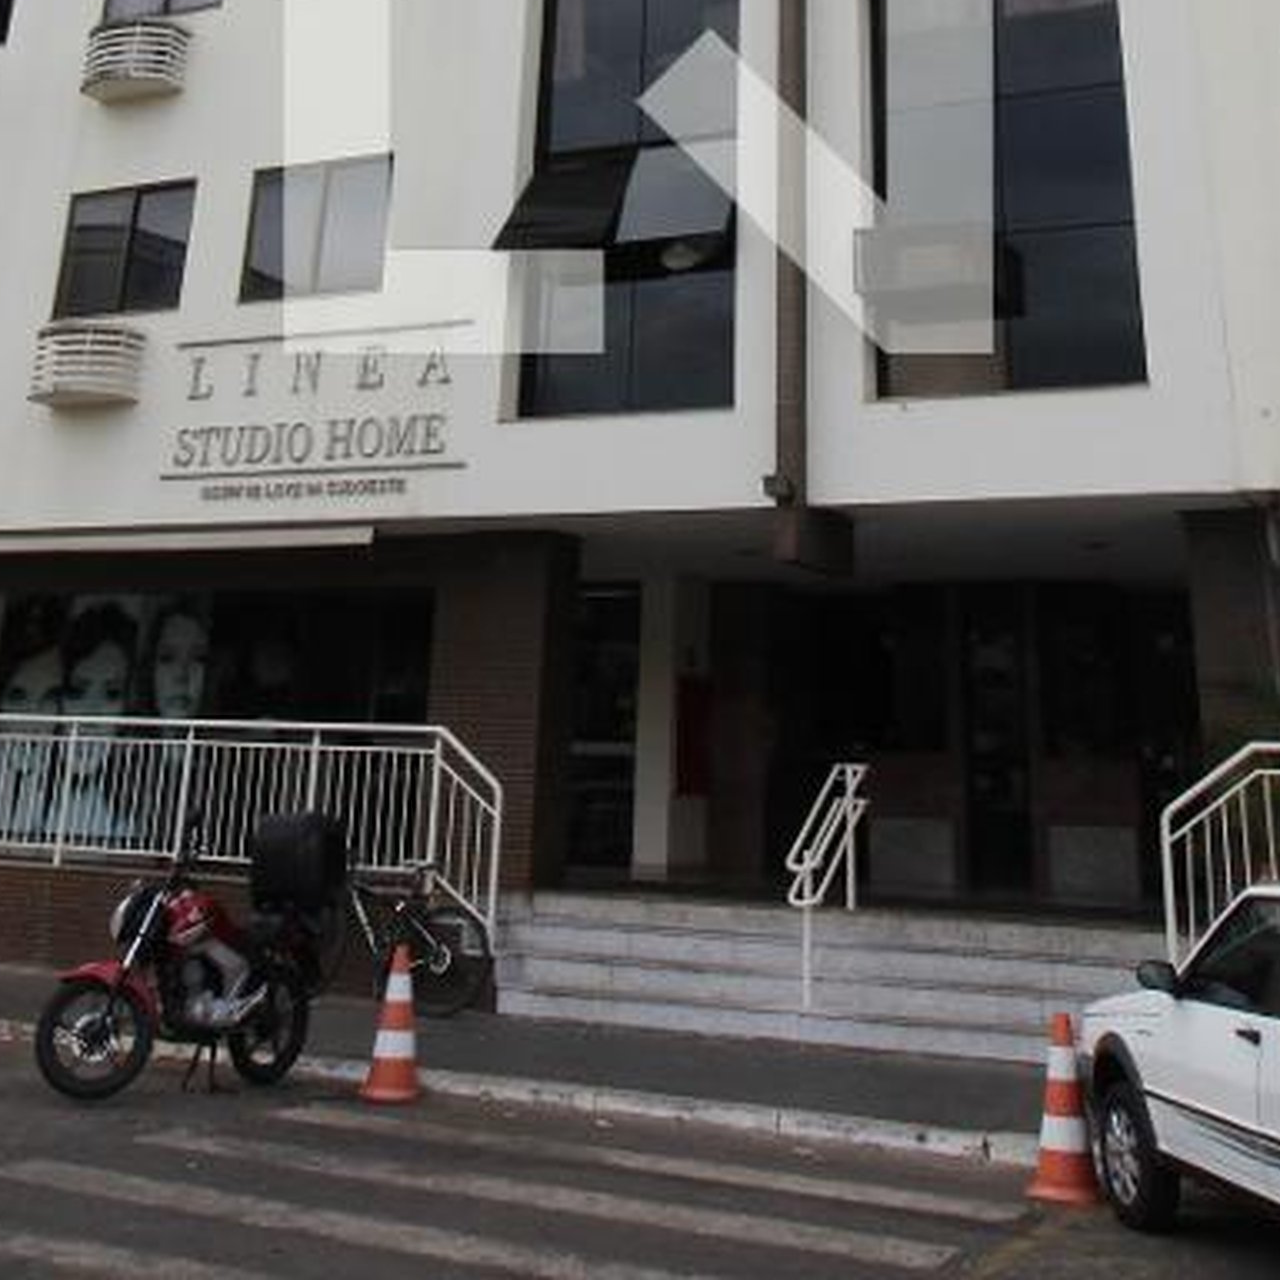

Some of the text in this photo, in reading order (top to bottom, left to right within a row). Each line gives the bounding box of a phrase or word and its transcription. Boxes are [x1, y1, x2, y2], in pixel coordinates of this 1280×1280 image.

[187, 346, 452, 400] LINEA
[173, 414, 446, 467] STUDIO HOME
